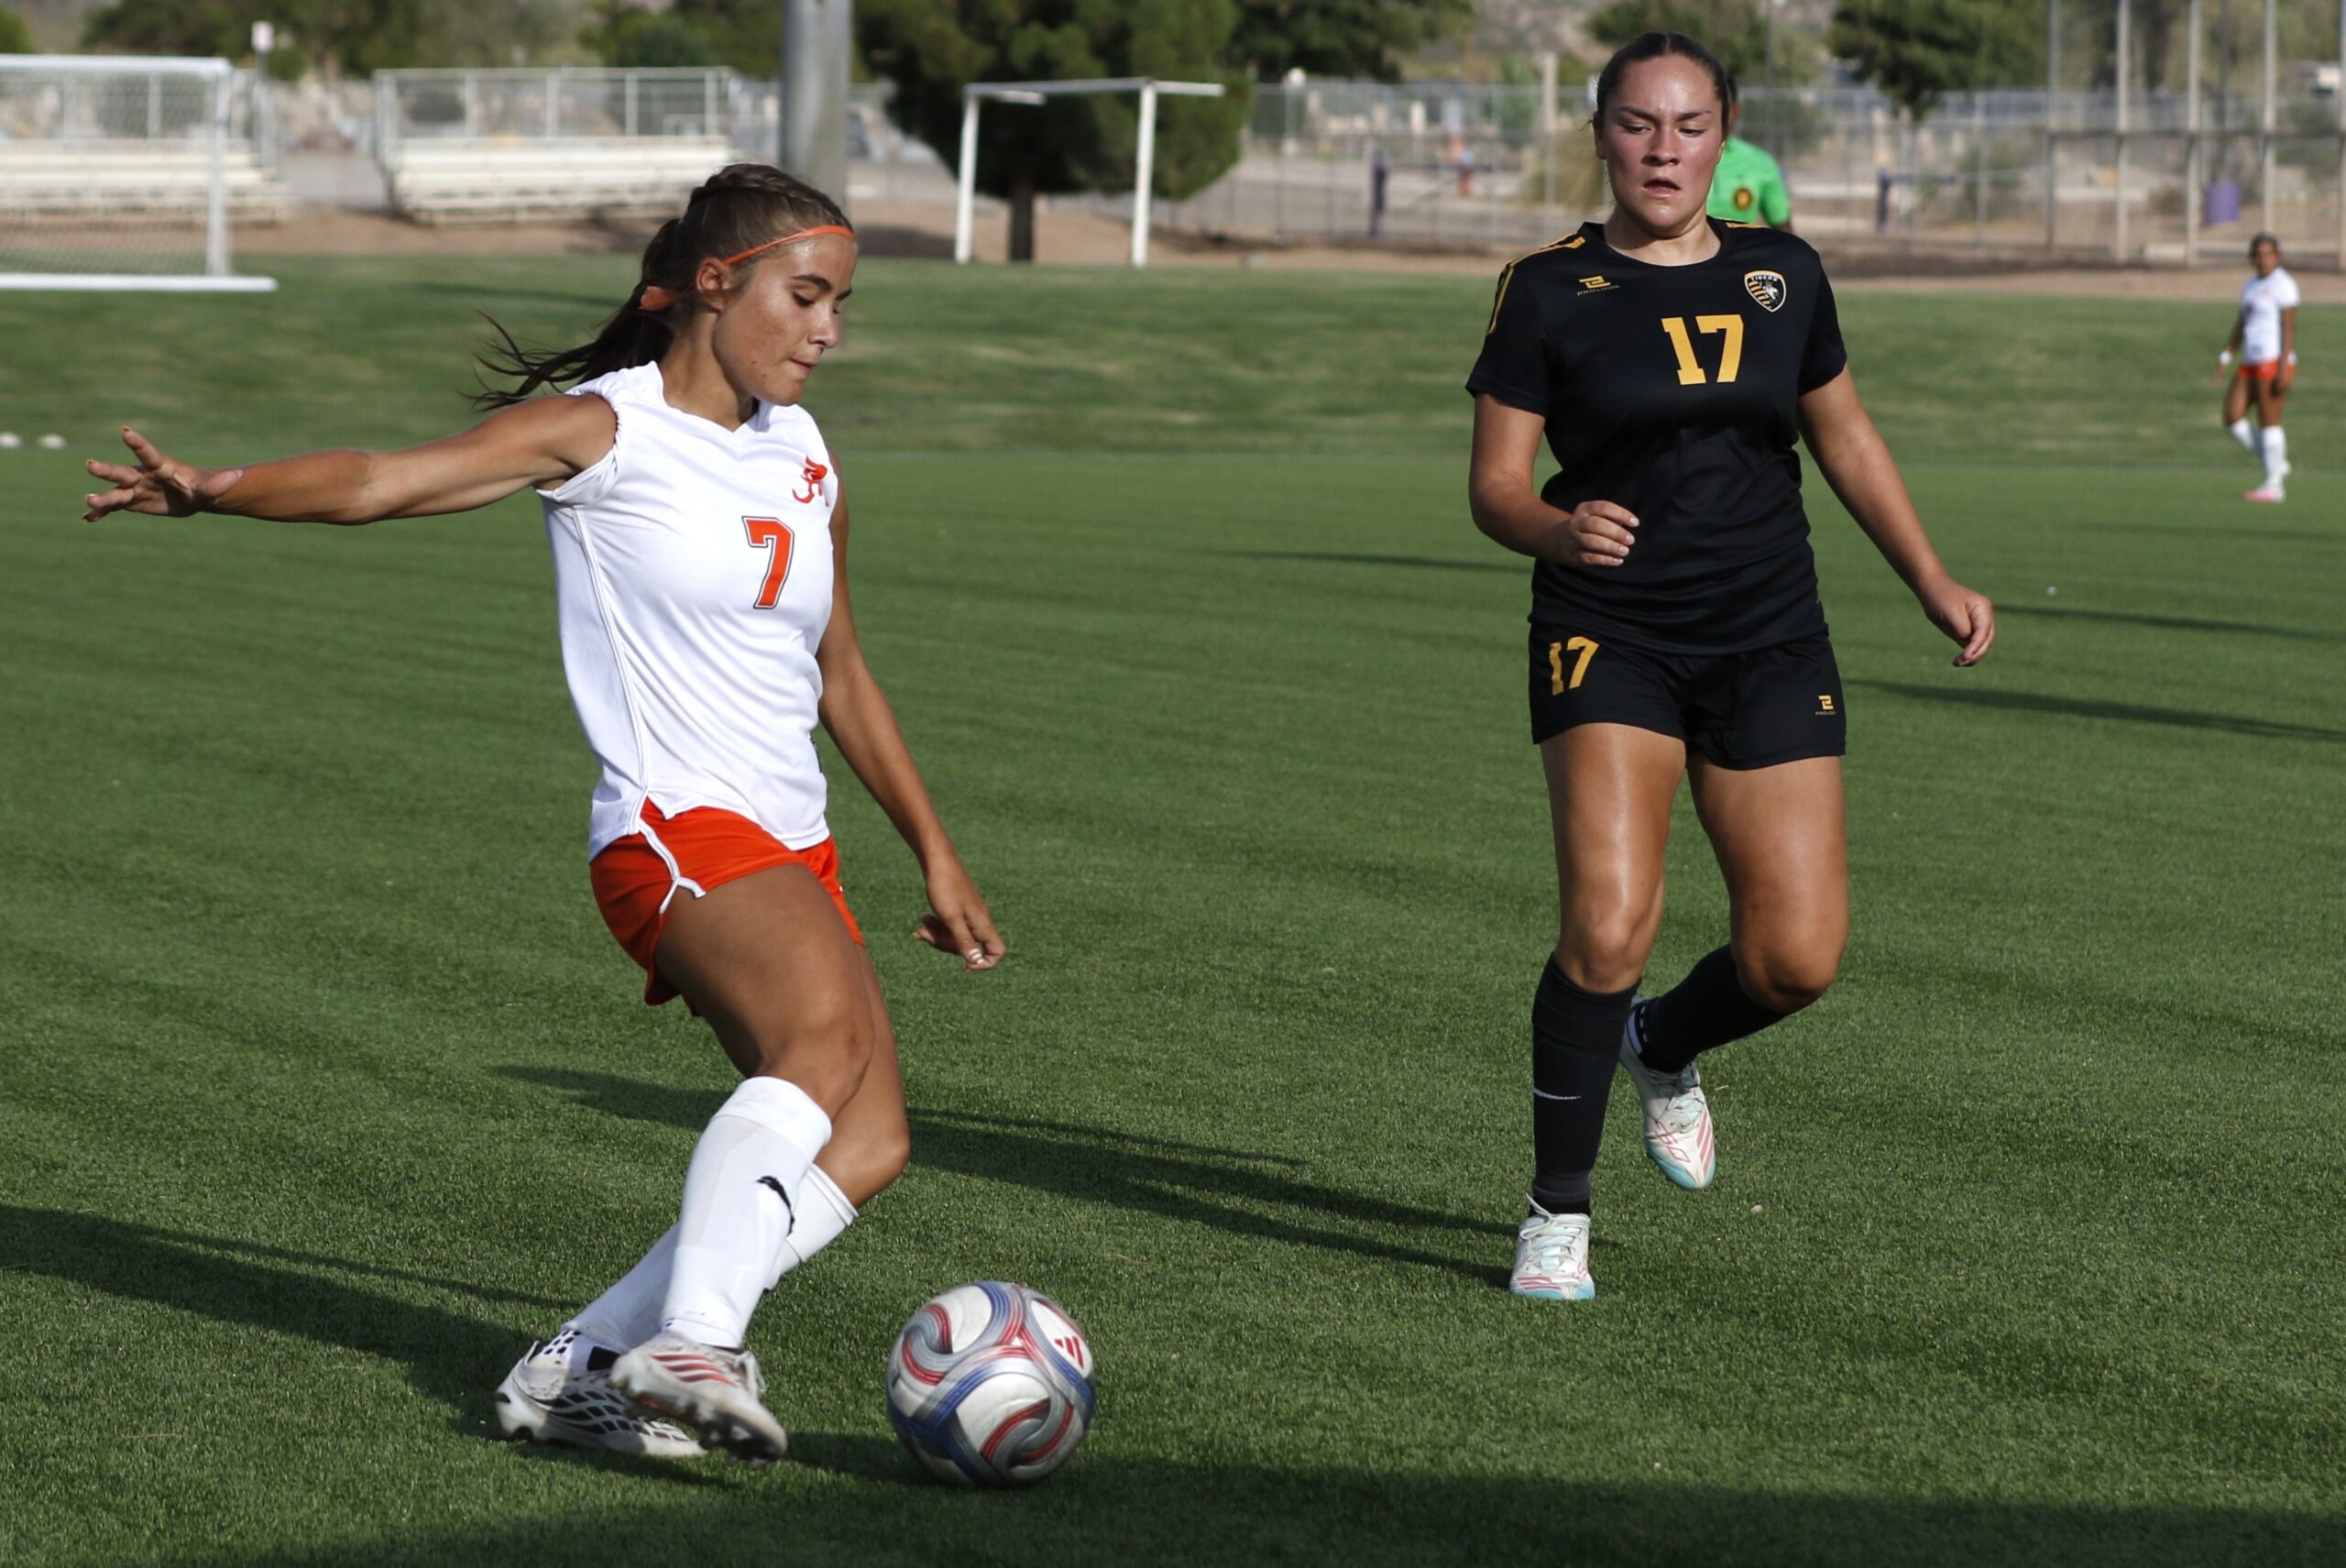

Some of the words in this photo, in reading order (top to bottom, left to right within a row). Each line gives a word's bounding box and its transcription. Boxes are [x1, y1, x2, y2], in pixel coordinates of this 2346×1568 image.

[1661, 314, 1744, 386] 17
[741, 515, 795, 609] 7
[1549, 636, 1600, 696] 17
